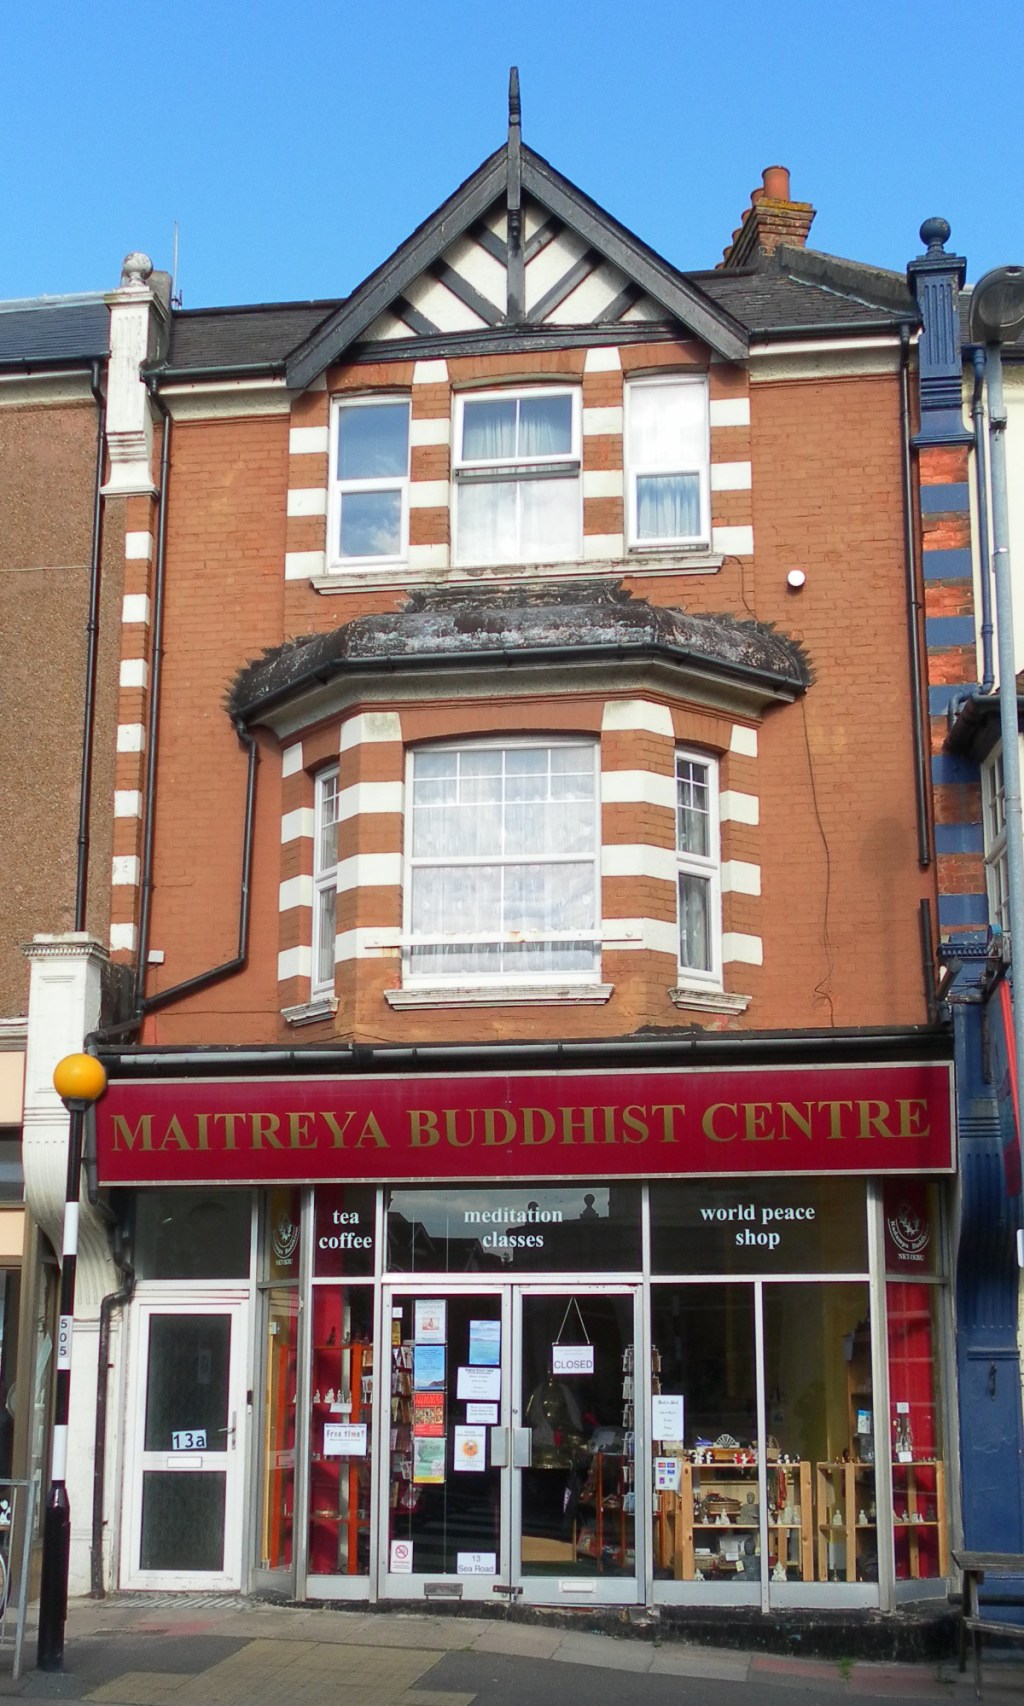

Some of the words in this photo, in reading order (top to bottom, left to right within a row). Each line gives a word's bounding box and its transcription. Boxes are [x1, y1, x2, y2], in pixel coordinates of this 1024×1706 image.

[110, 1110, 391, 1152] MAITREYA
[407, 1103, 686, 1147] BUDDHIST
[701, 1097, 931, 1143] CENTRE
[333, 1209, 359, 1225] tea
[464, 1207, 563, 1223] meditation
[700, 1204, 756, 1221] world
[762, 1207, 815, 1226] peace
[318, 1231, 373, 1249] coffee
[482, 1231, 544, 1248] classes
[735, 1228, 780, 1250] shop
[59, 1318, 68, 1356] 505
[554, 1360, 593, 1369] CLOSED
[173, 1431, 206, 1448] 13a
[458, 1565, 473, 1573] Sea
[474, 1565, 494, 1573] Road
